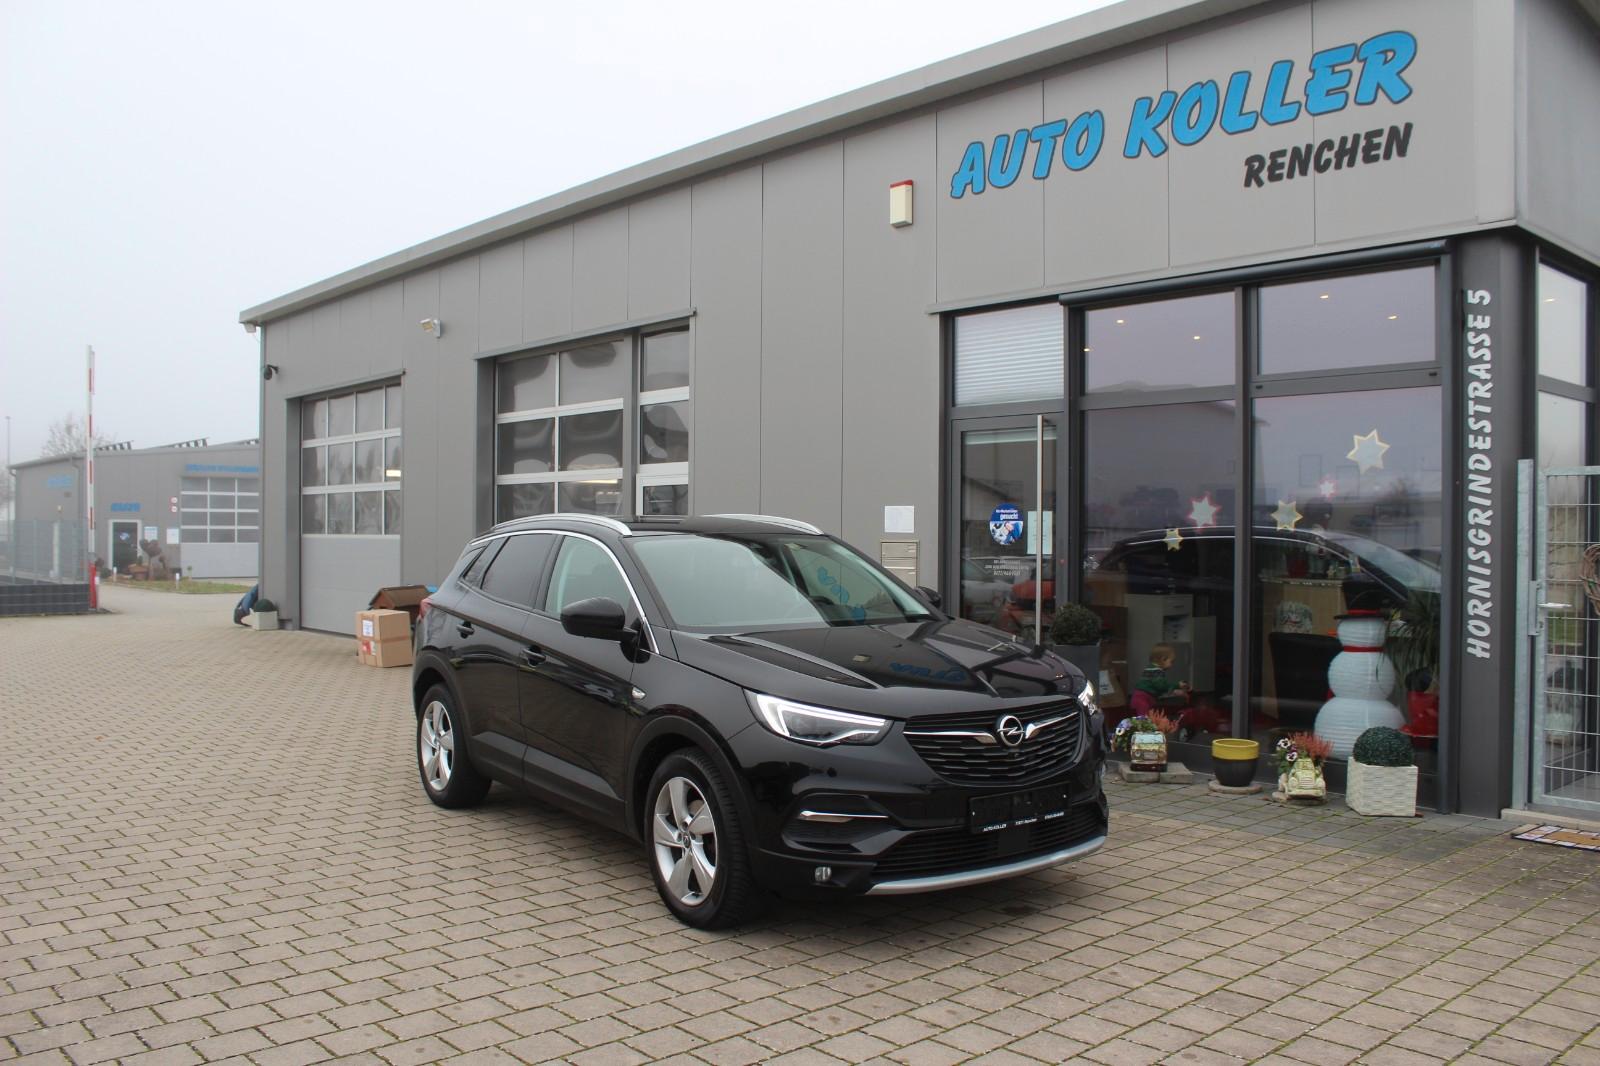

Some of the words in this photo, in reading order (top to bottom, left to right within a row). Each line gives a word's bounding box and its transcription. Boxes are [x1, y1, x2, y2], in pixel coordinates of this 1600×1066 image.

[950, 110, 1104, 199] AUTO
[1123, 30, 1417, 159] KOLLER
[1243, 122, 1413, 188] RENCHEN
[1467, 288, 1492, 307] 5
[1466, 315, 1494, 659] HORNISGRINDESTRASSE
